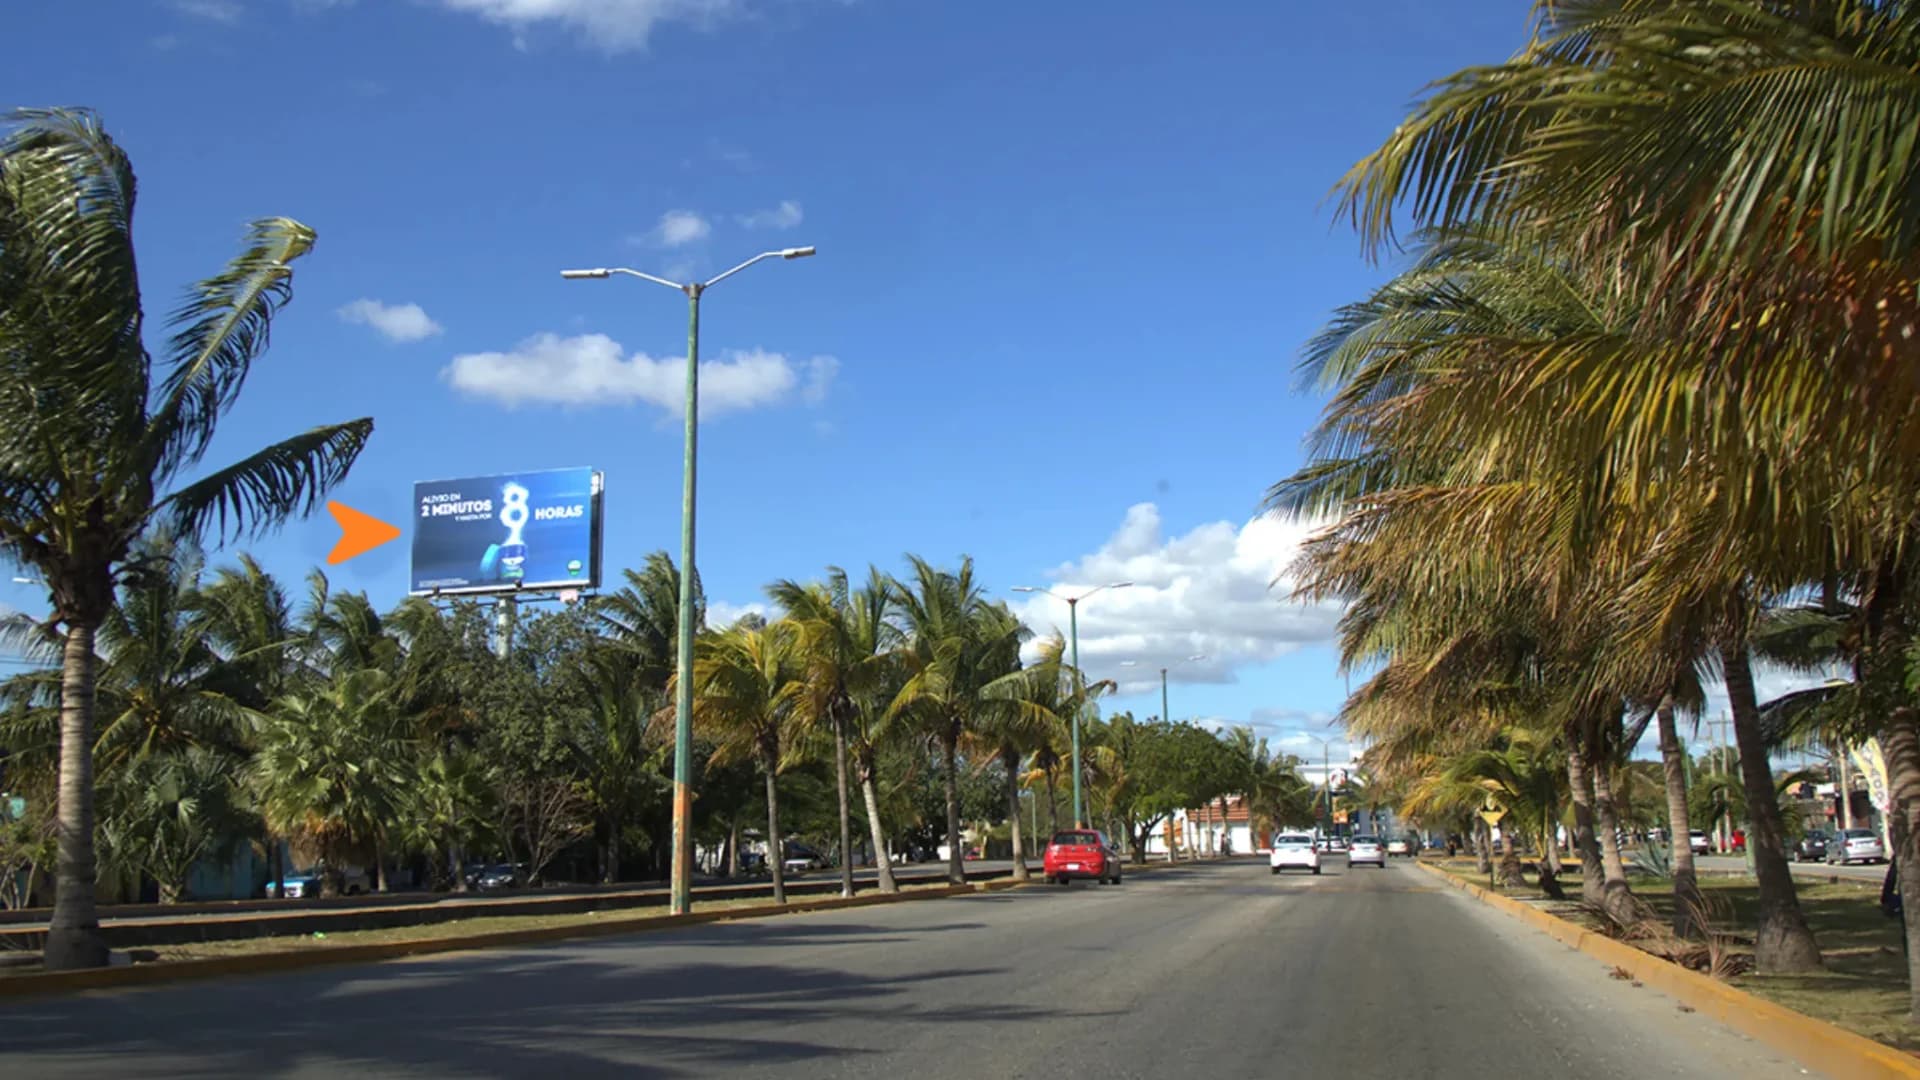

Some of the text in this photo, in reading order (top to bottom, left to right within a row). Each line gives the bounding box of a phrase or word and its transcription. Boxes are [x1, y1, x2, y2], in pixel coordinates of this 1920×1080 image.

[422, 493, 461, 504] ALIVIO EN
[500, 481, 584, 527] 8 HORAS
[421, 499, 493, 517] 2 MINUTOS
